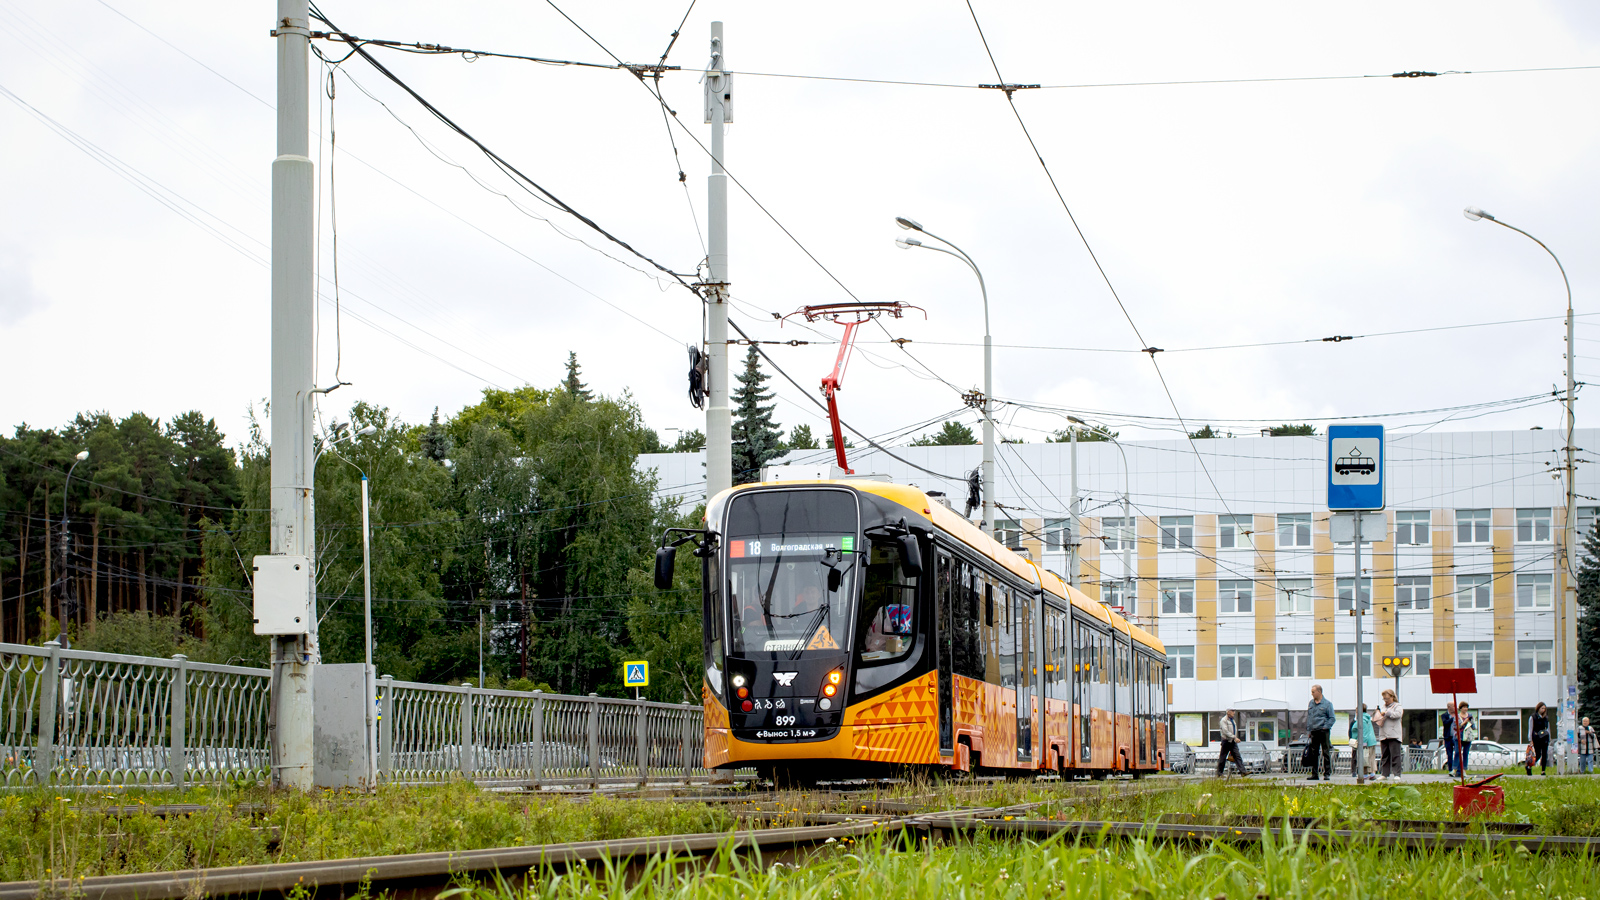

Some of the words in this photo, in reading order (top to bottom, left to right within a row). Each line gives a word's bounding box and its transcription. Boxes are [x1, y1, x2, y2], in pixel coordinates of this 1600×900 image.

[748, 541, 761, 555] 18
[771, 543, 823, 551] Волгоградская
[775, 715, 796, 726] 899
[790, 729, 801, 738] 1,5
